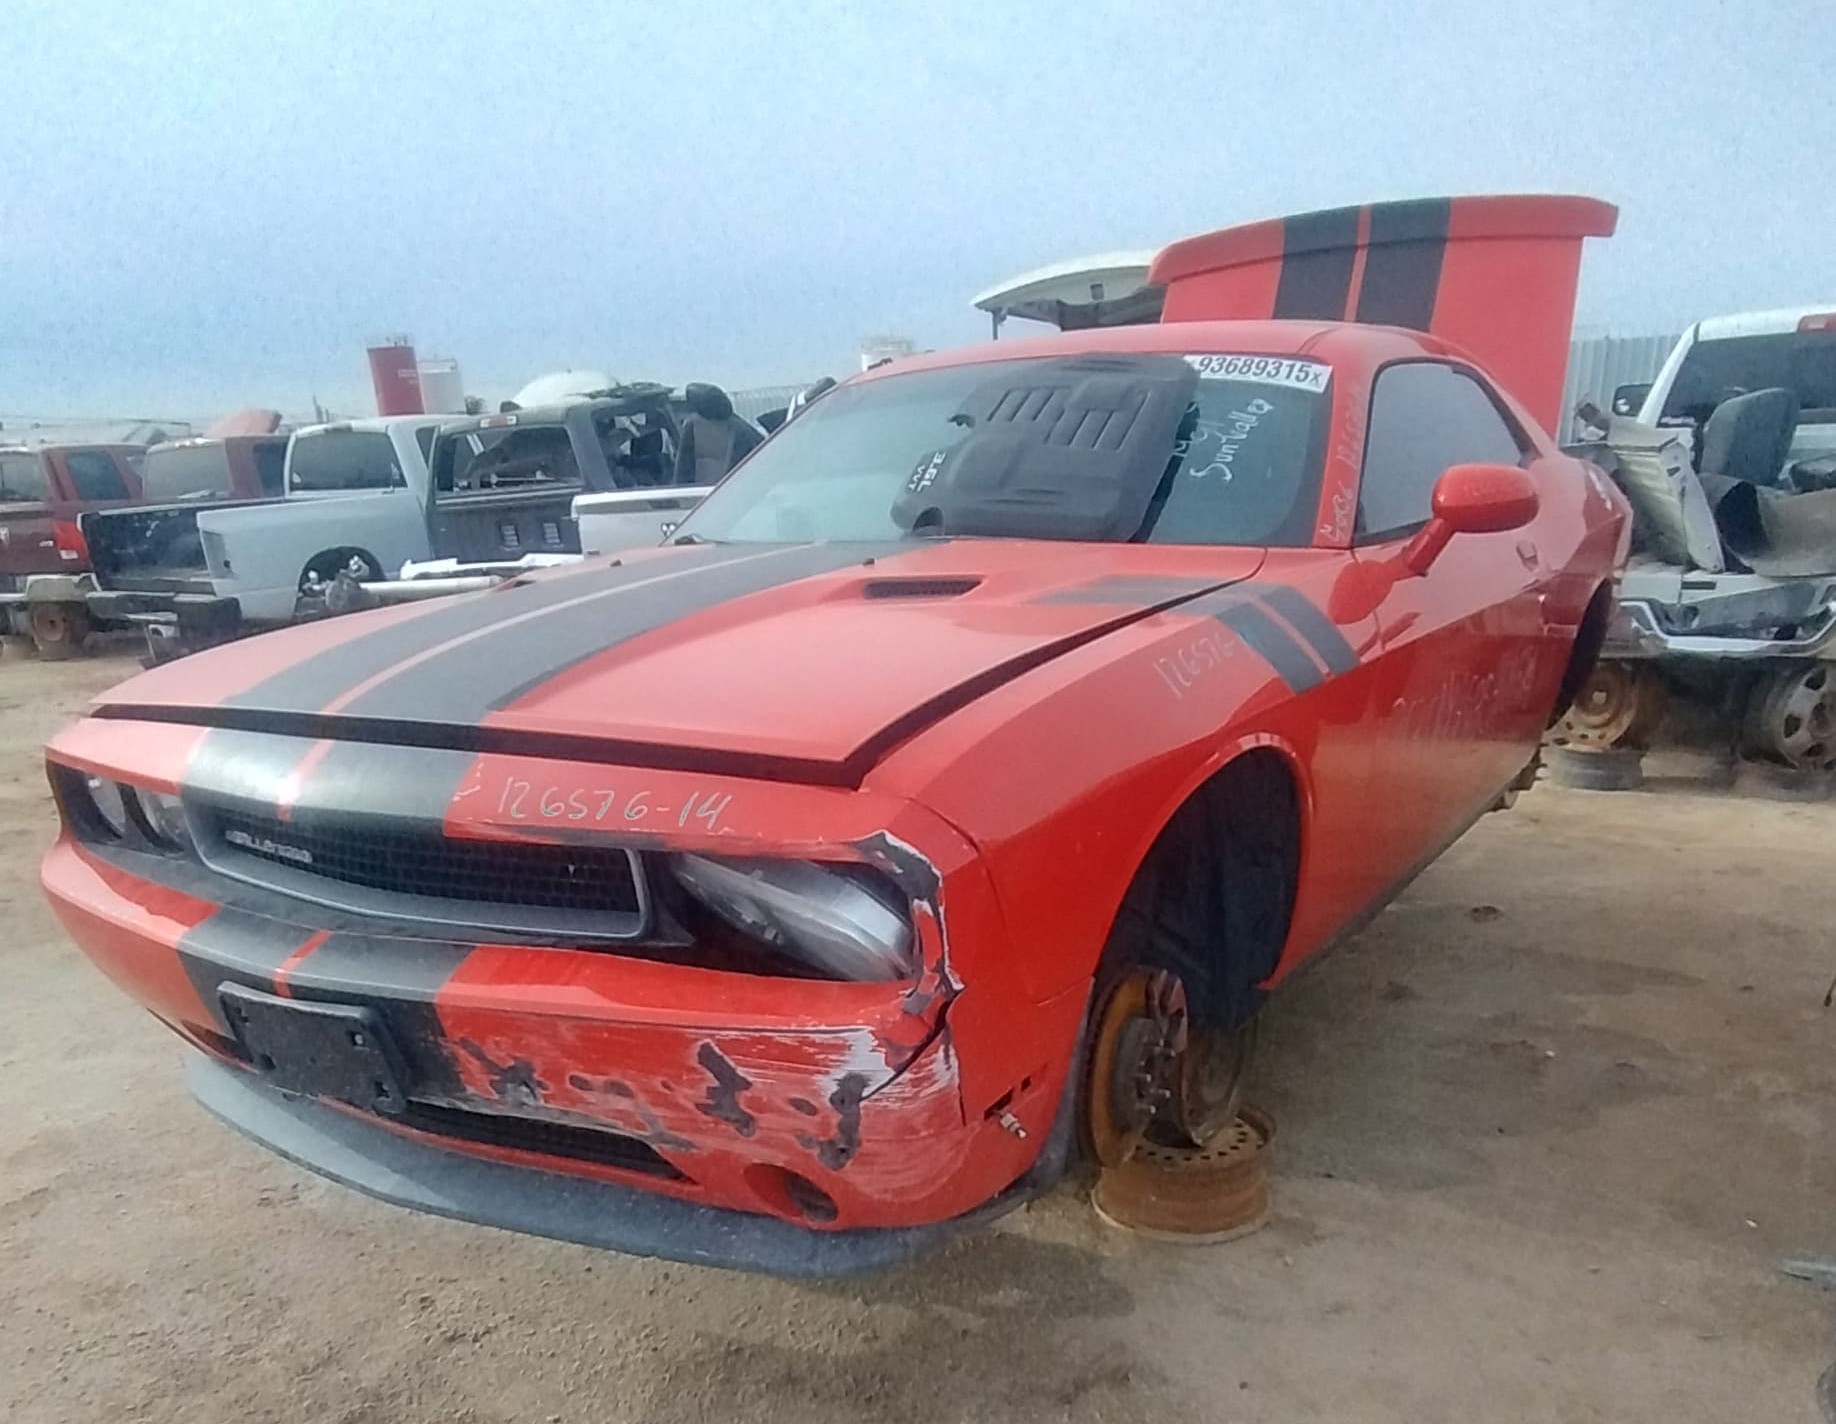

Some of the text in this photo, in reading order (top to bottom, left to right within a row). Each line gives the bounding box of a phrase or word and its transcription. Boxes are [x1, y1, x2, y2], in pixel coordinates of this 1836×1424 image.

[908, 464, 927, 491] VVT
[917, 450, 947, 492] 3.6L
[497, 775, 732, 831] 126576-14
